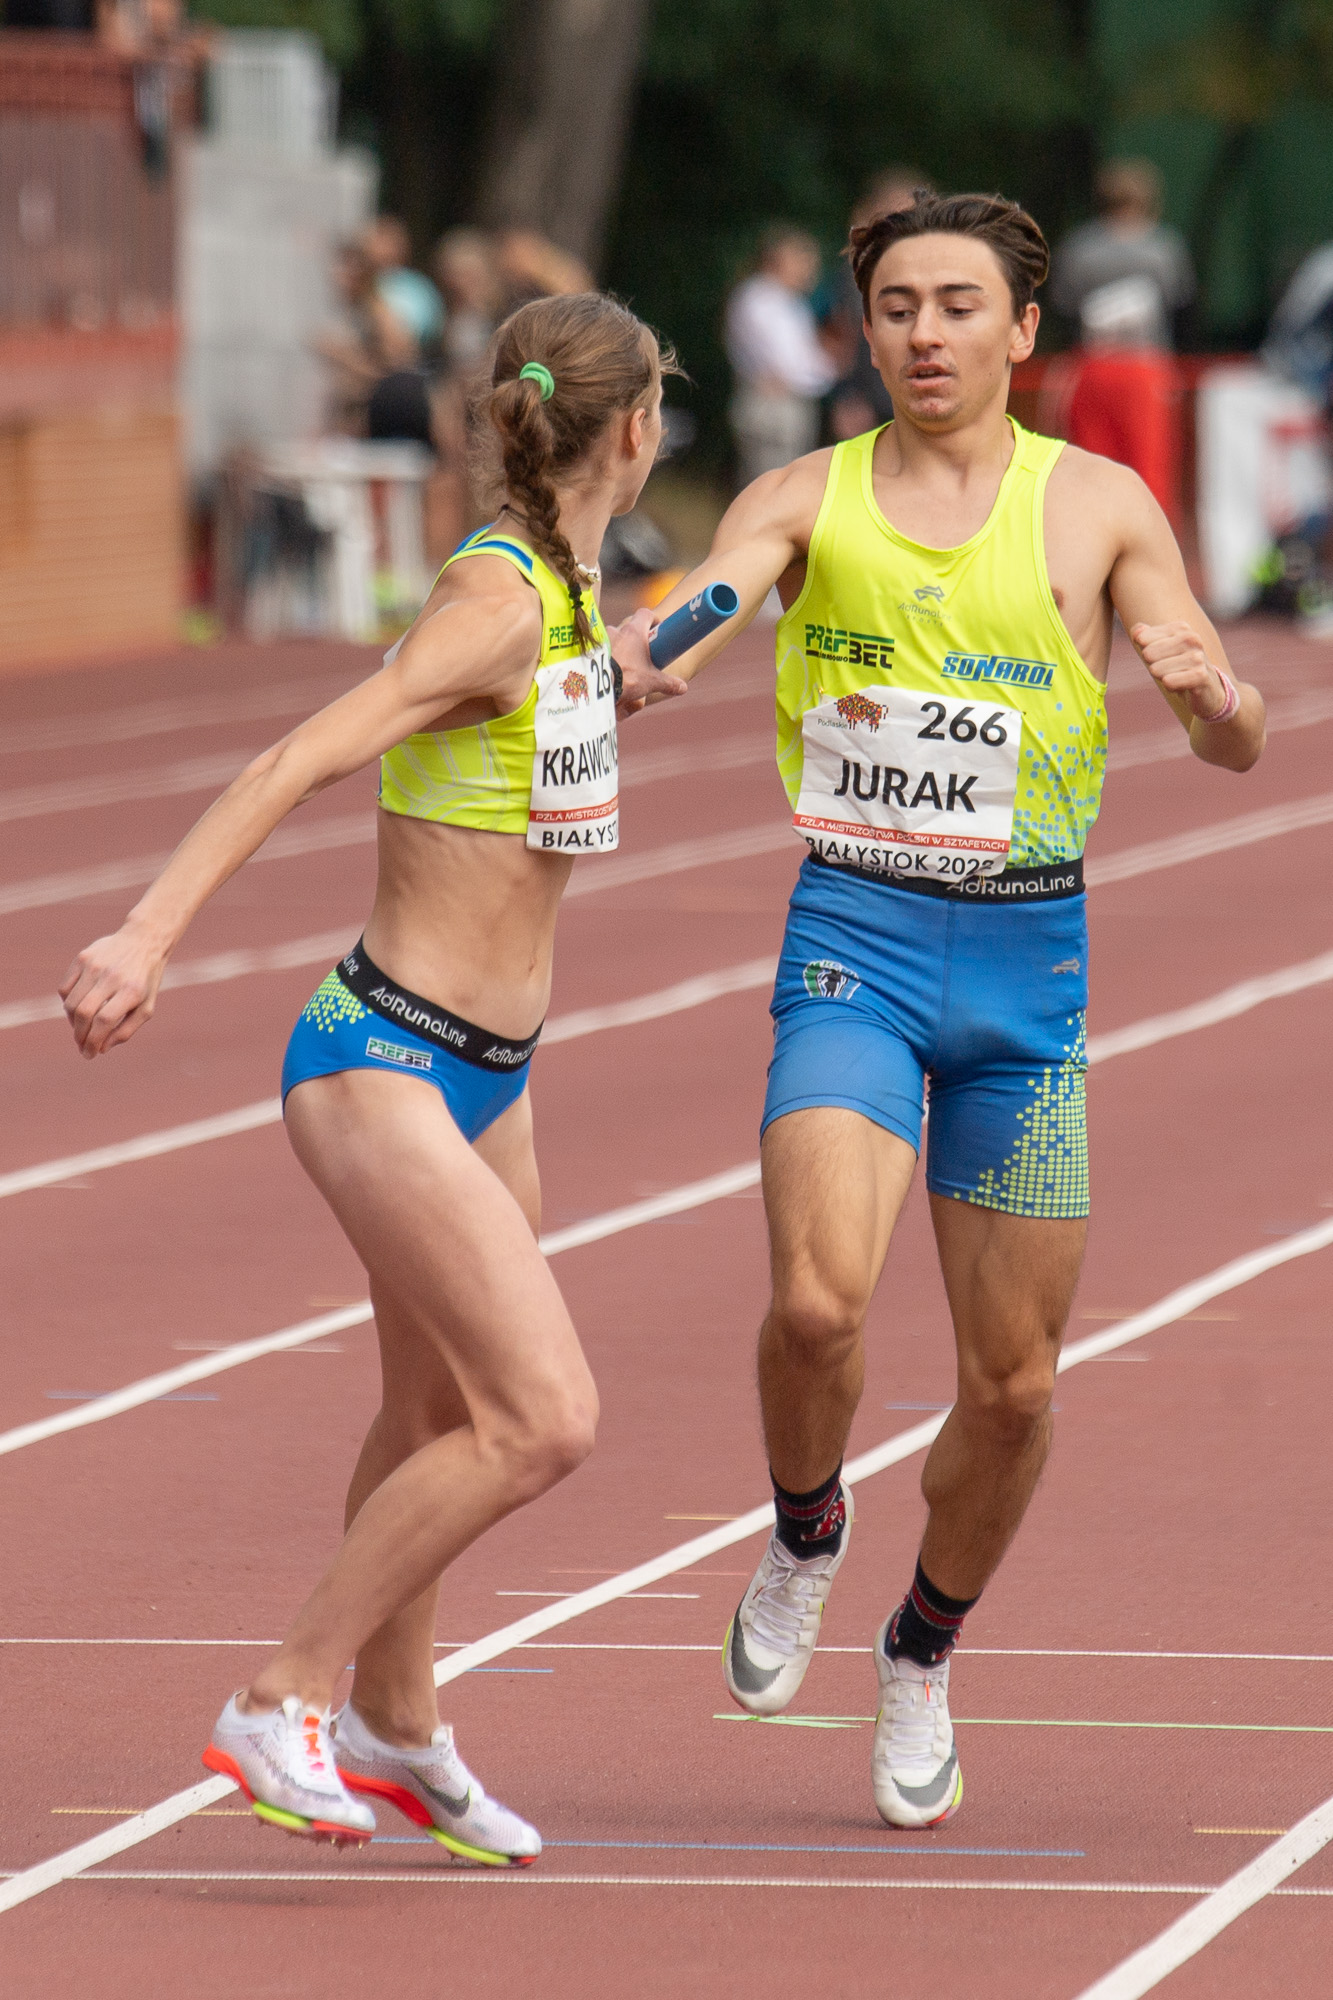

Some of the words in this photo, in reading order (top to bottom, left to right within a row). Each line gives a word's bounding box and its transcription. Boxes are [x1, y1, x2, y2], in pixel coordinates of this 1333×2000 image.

[942, 655, 1054, 681] SONAROL
[817, 718, 848, 729] Podlaskie
[917, 701, 1008, 747] 266
[833, 759, 979, 813] JURAK
[536, 811, 563, 821] PZLA
[799, 816, 825, 829] PZLA
[826, 822, 895, 840] MISTRZOSTWA
[896, 832, 930, 844] POLSKI
[931, 837, 942, 845] W
[943, 837, 1006, 850] SZTAFETACH
[805, 836, 929, 872] BIAŁYSTOK
[946, 874, 1076, 896] AdRunaLine
[368, 986, 468, 1049] AdRunaLine
